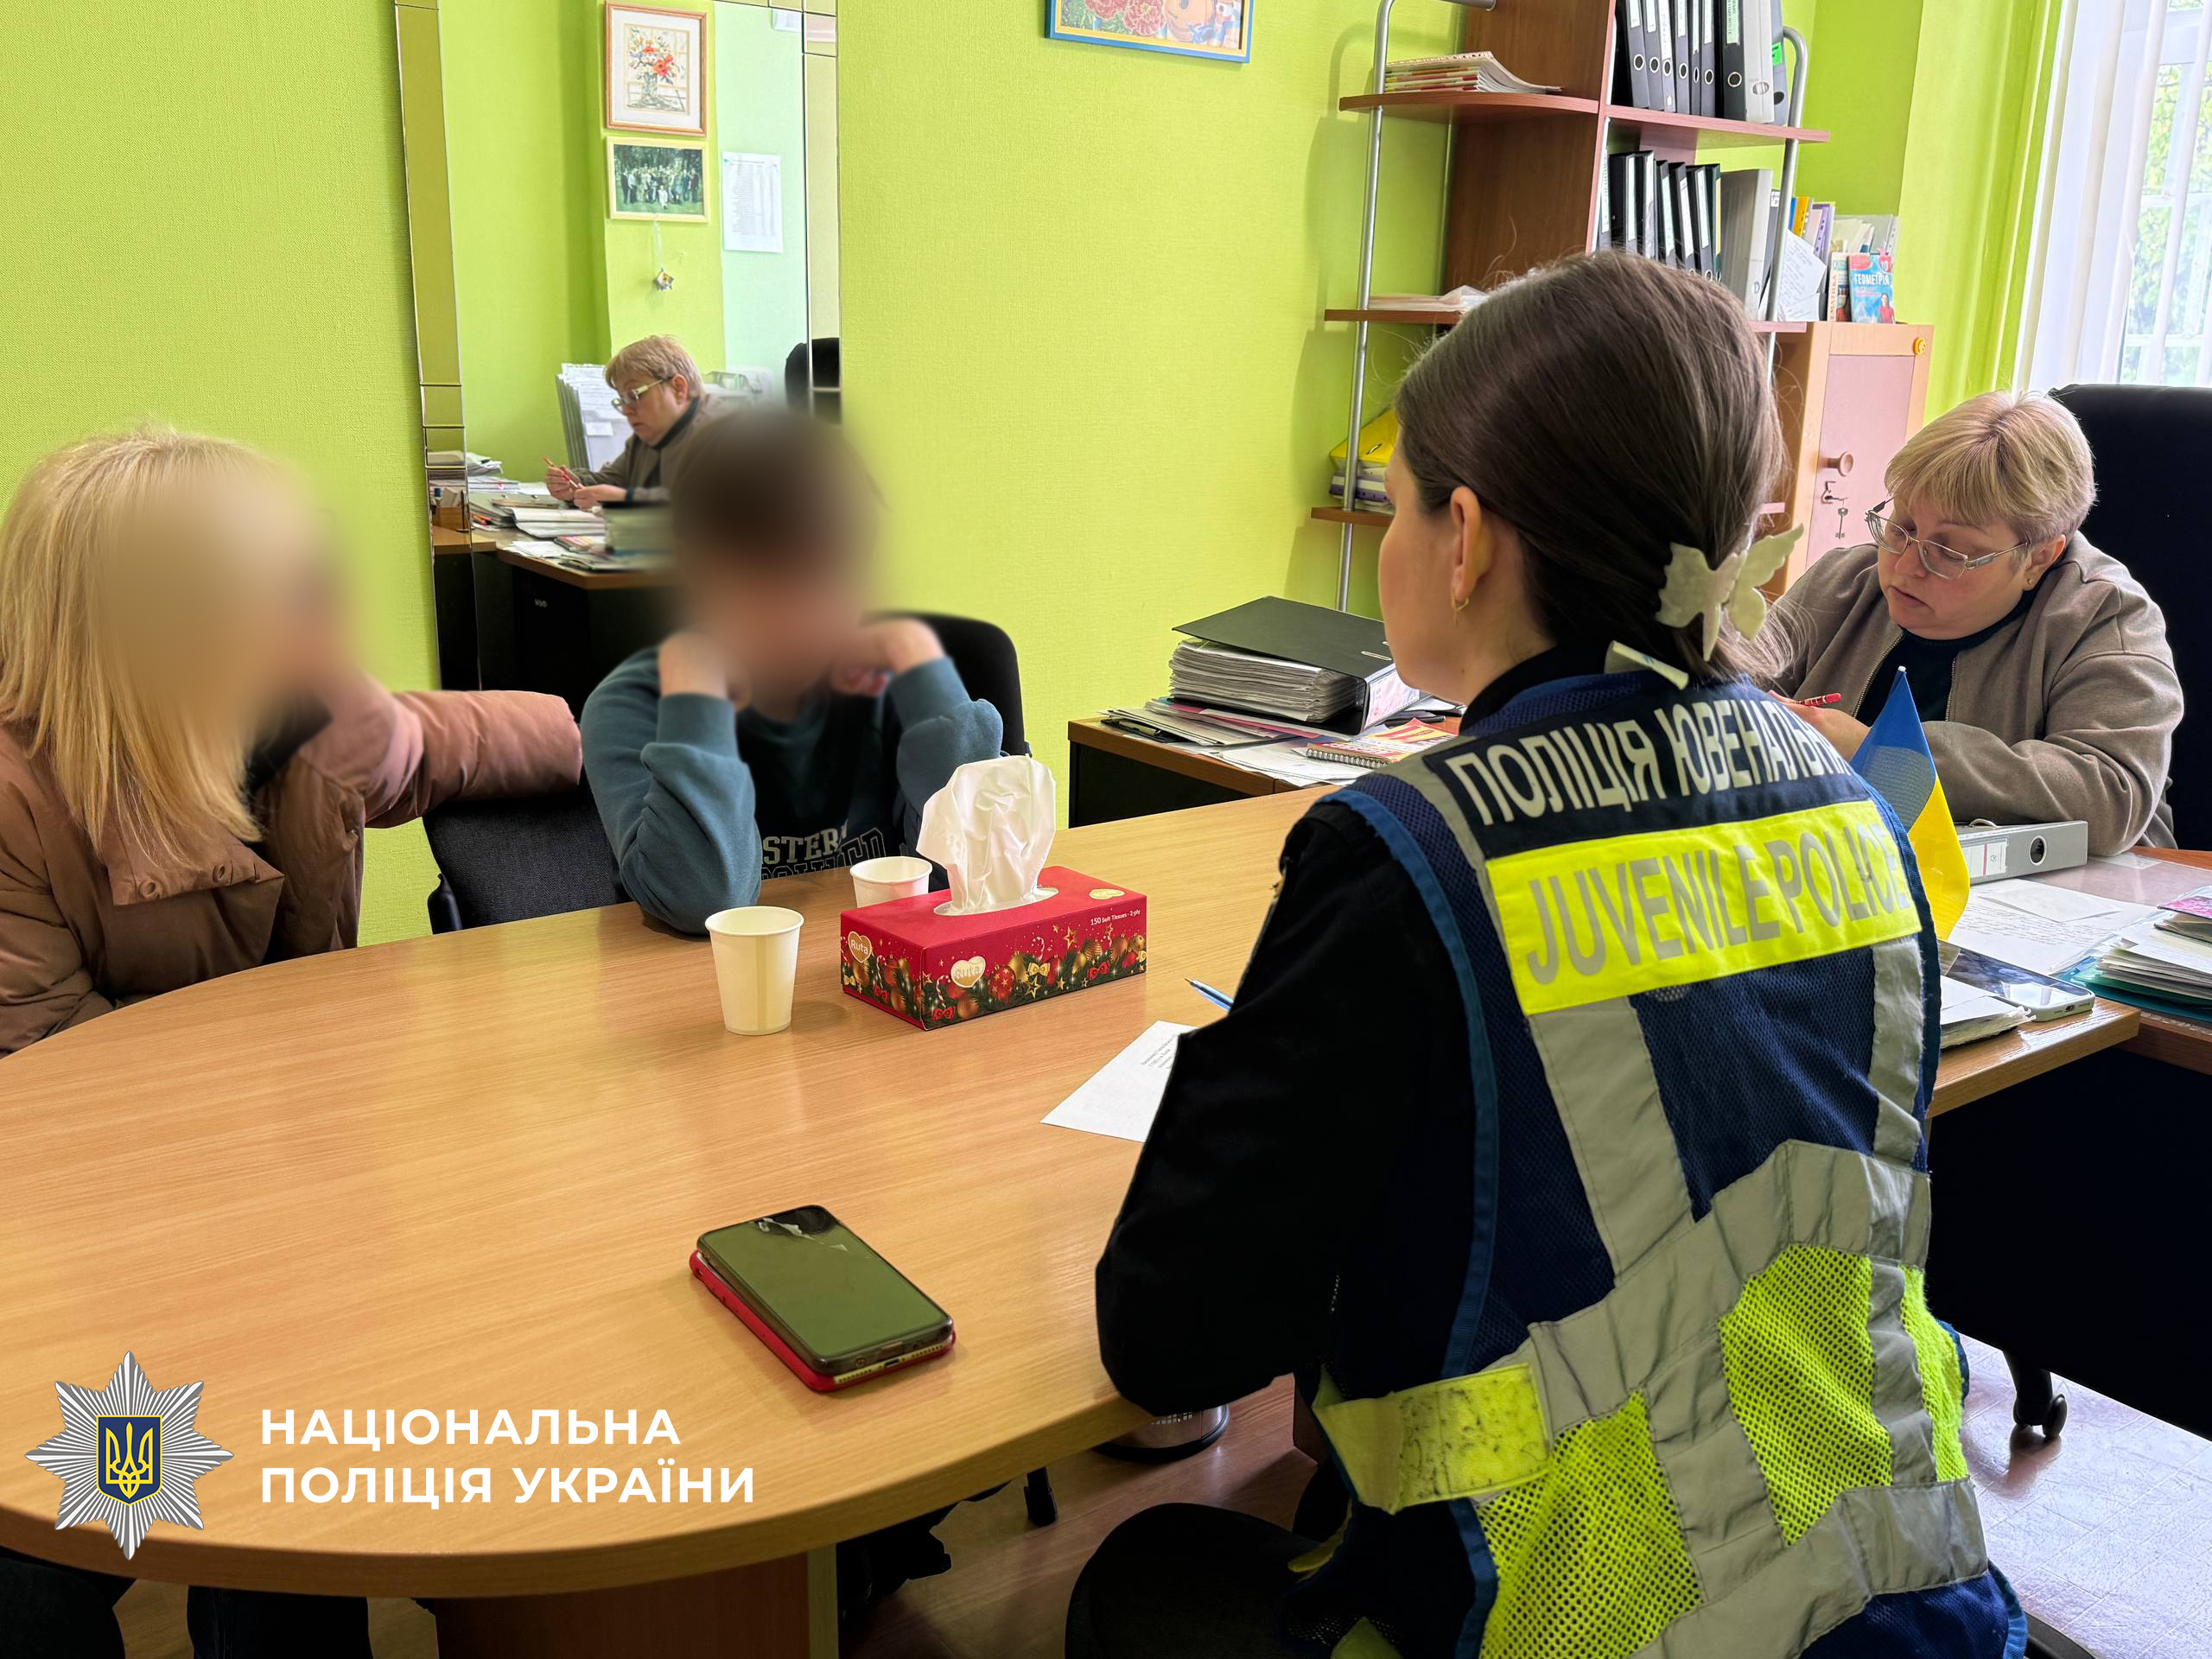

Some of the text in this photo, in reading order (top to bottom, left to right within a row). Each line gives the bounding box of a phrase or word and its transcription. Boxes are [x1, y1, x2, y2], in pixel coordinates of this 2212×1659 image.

[1444, 719, 1668, 826] ПОЛІЦІЯ
[1527, 823, 1910, 985] JUVENILE POLICE
[1090, 917, 1102, 926] 150
[849, 939, 869, 955] Ruta
[954, 963, 982, 980] Ruta
